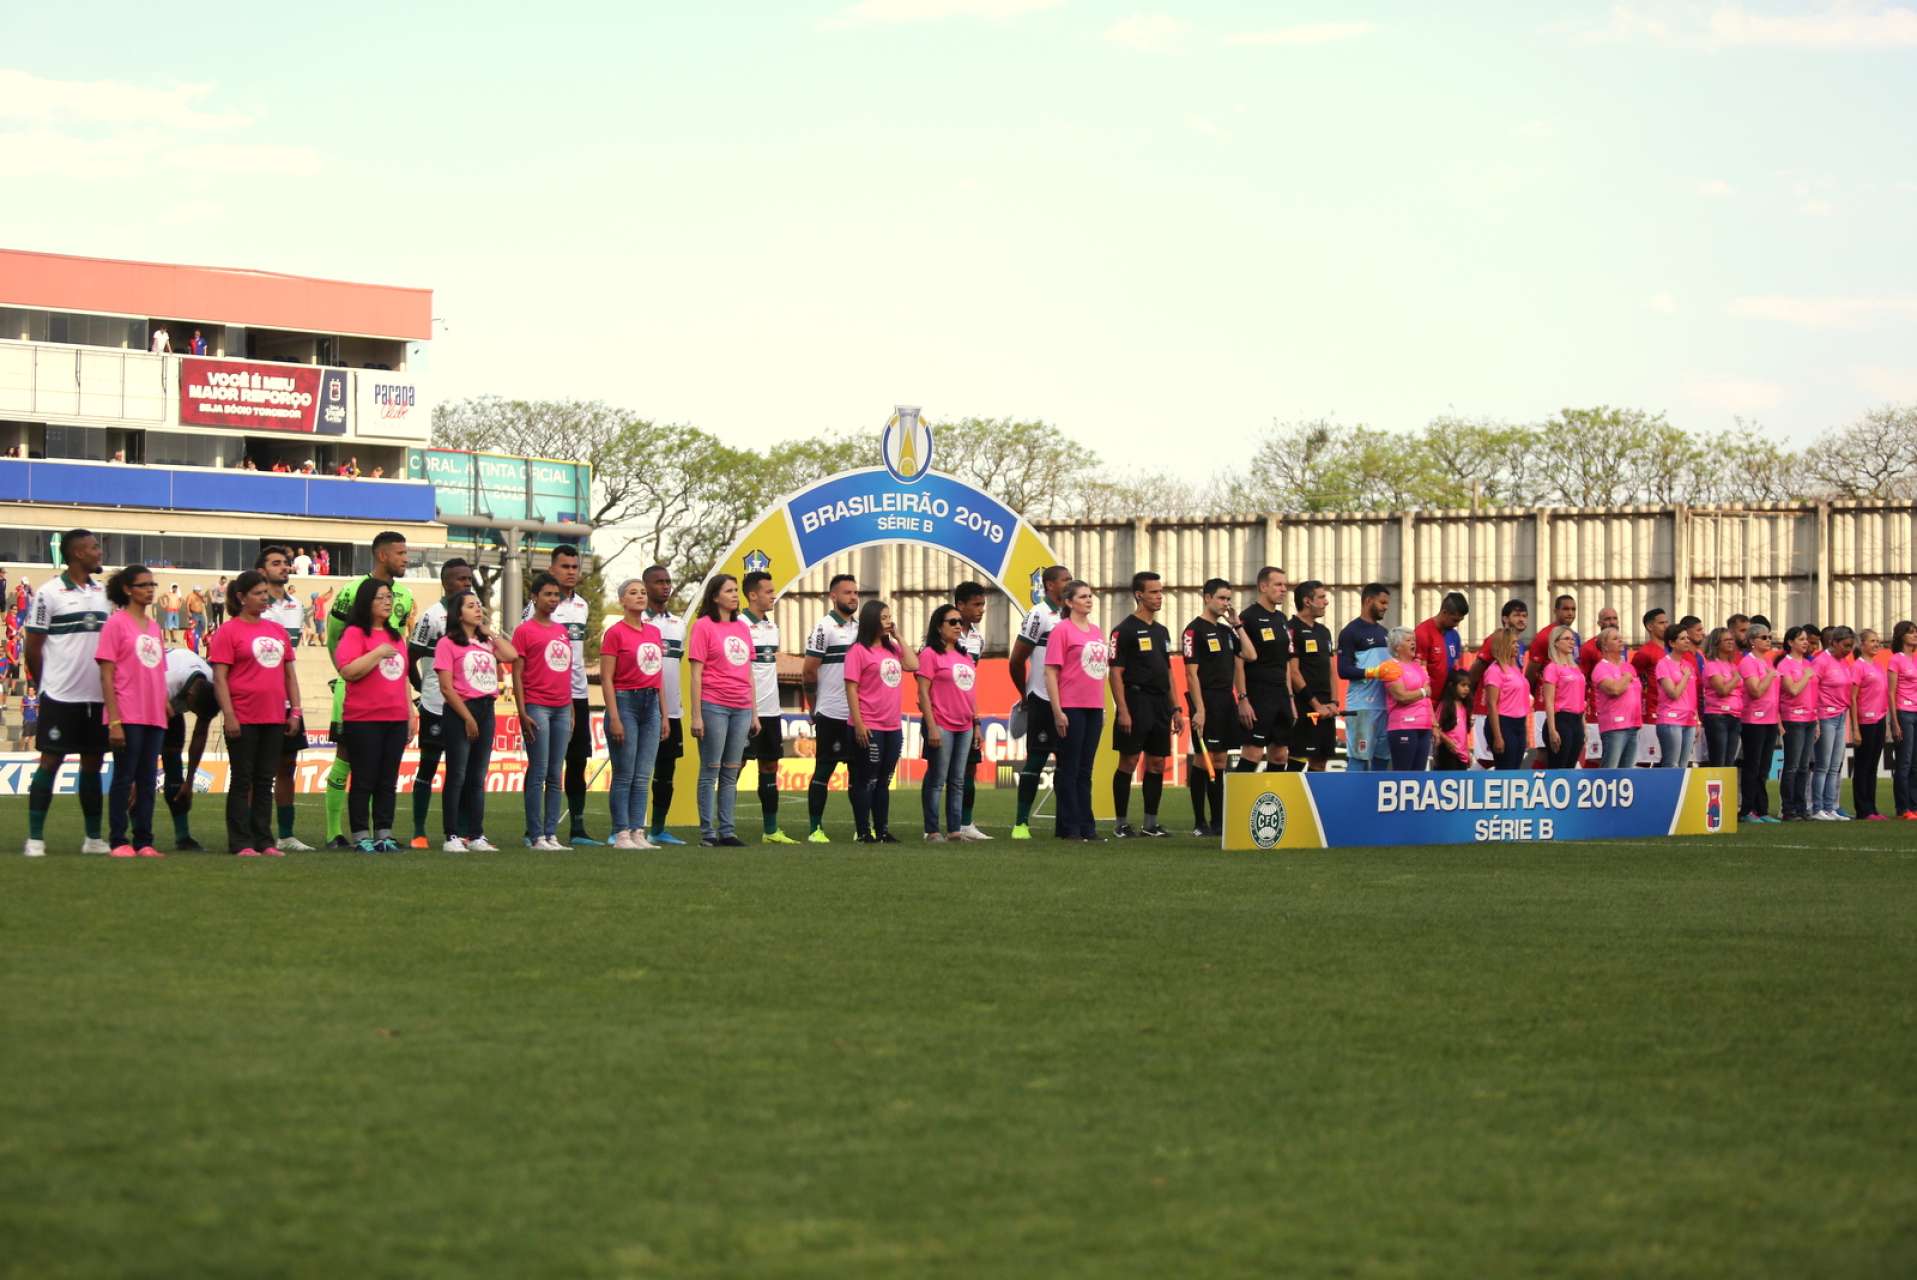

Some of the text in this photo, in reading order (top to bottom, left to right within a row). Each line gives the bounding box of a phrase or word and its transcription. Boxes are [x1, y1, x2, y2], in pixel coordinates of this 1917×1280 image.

[207, 371, 249, 388] VOCÊ
[263, 376, 296, 392] MEU
[188, 384, 312, 409] MAIOR REFORÇO
[801, 492, 1004, 544] BRASILEIRÃO 2019
[877, 514, 934, 533] SÉRIE B
[1377, 771, 1635, 813] BRASILEIRÃO 2019
[1258, 814, 1278, 828] CFC
[1475, 815, 1554, 841] SÉRIE B
